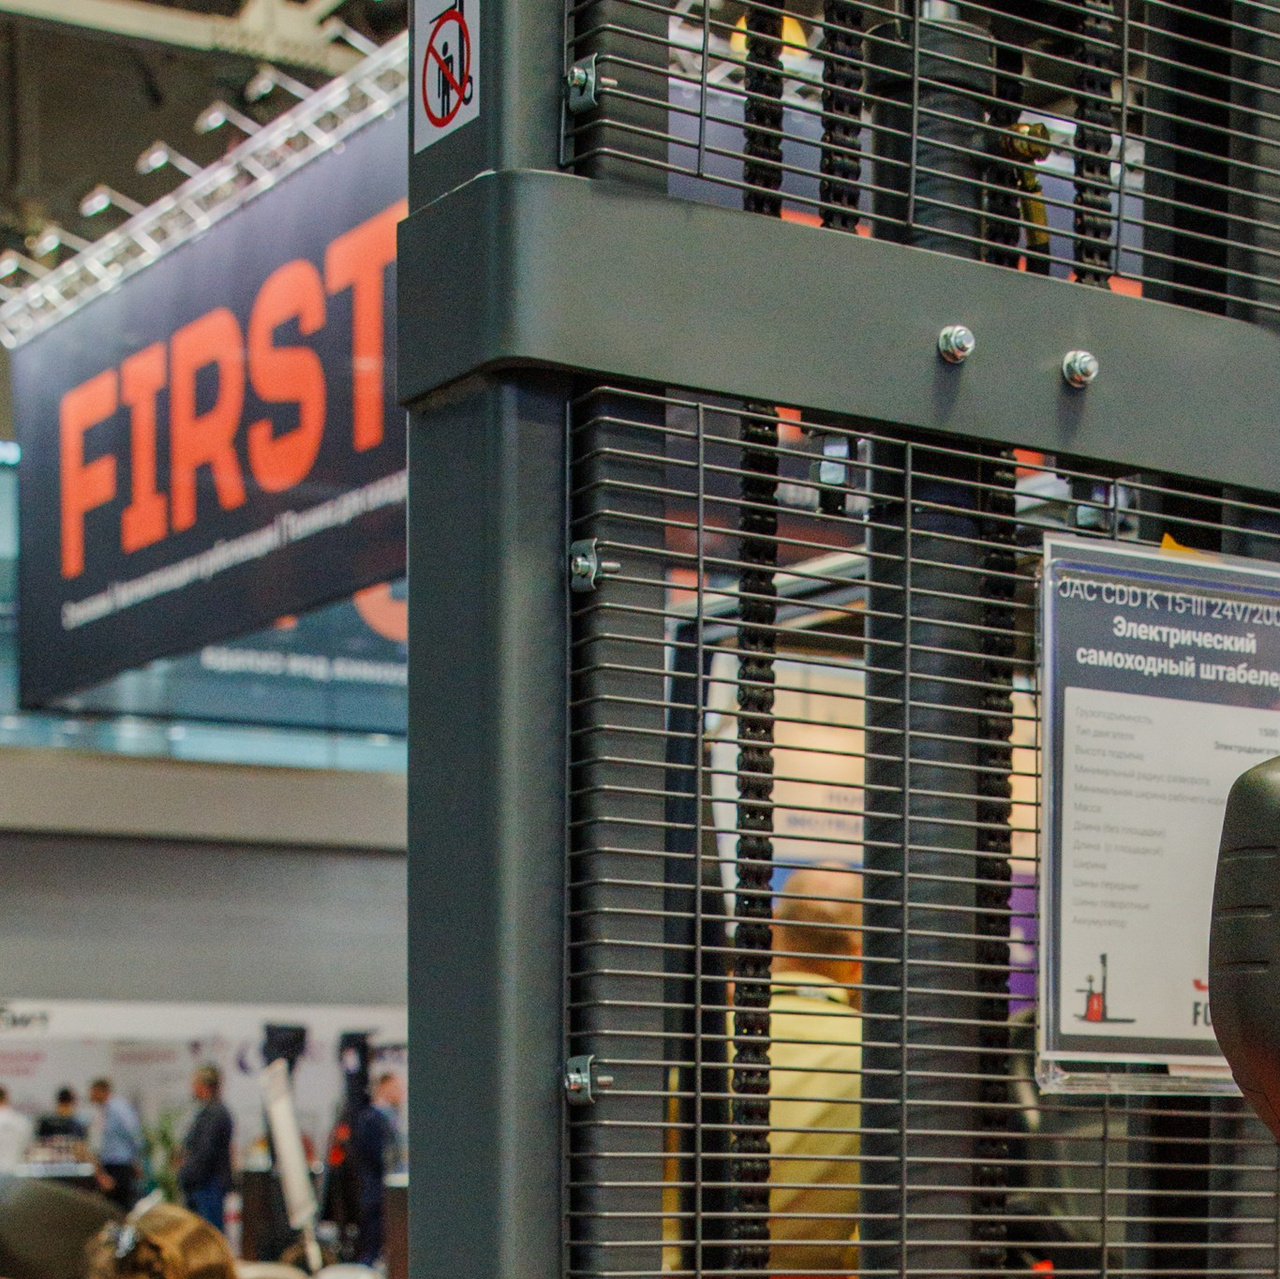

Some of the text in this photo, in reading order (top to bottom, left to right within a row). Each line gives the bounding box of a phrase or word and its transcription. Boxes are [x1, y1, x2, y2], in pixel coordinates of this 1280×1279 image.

[60, 199, 407, 579] FIRST
[1059, 578, 1097, 601] JAC
[1102, 582, 1141, 607] CDD
[1113, 615, 1256, 654] Электрический
[1076, 647, 1195, 678] самоходный
